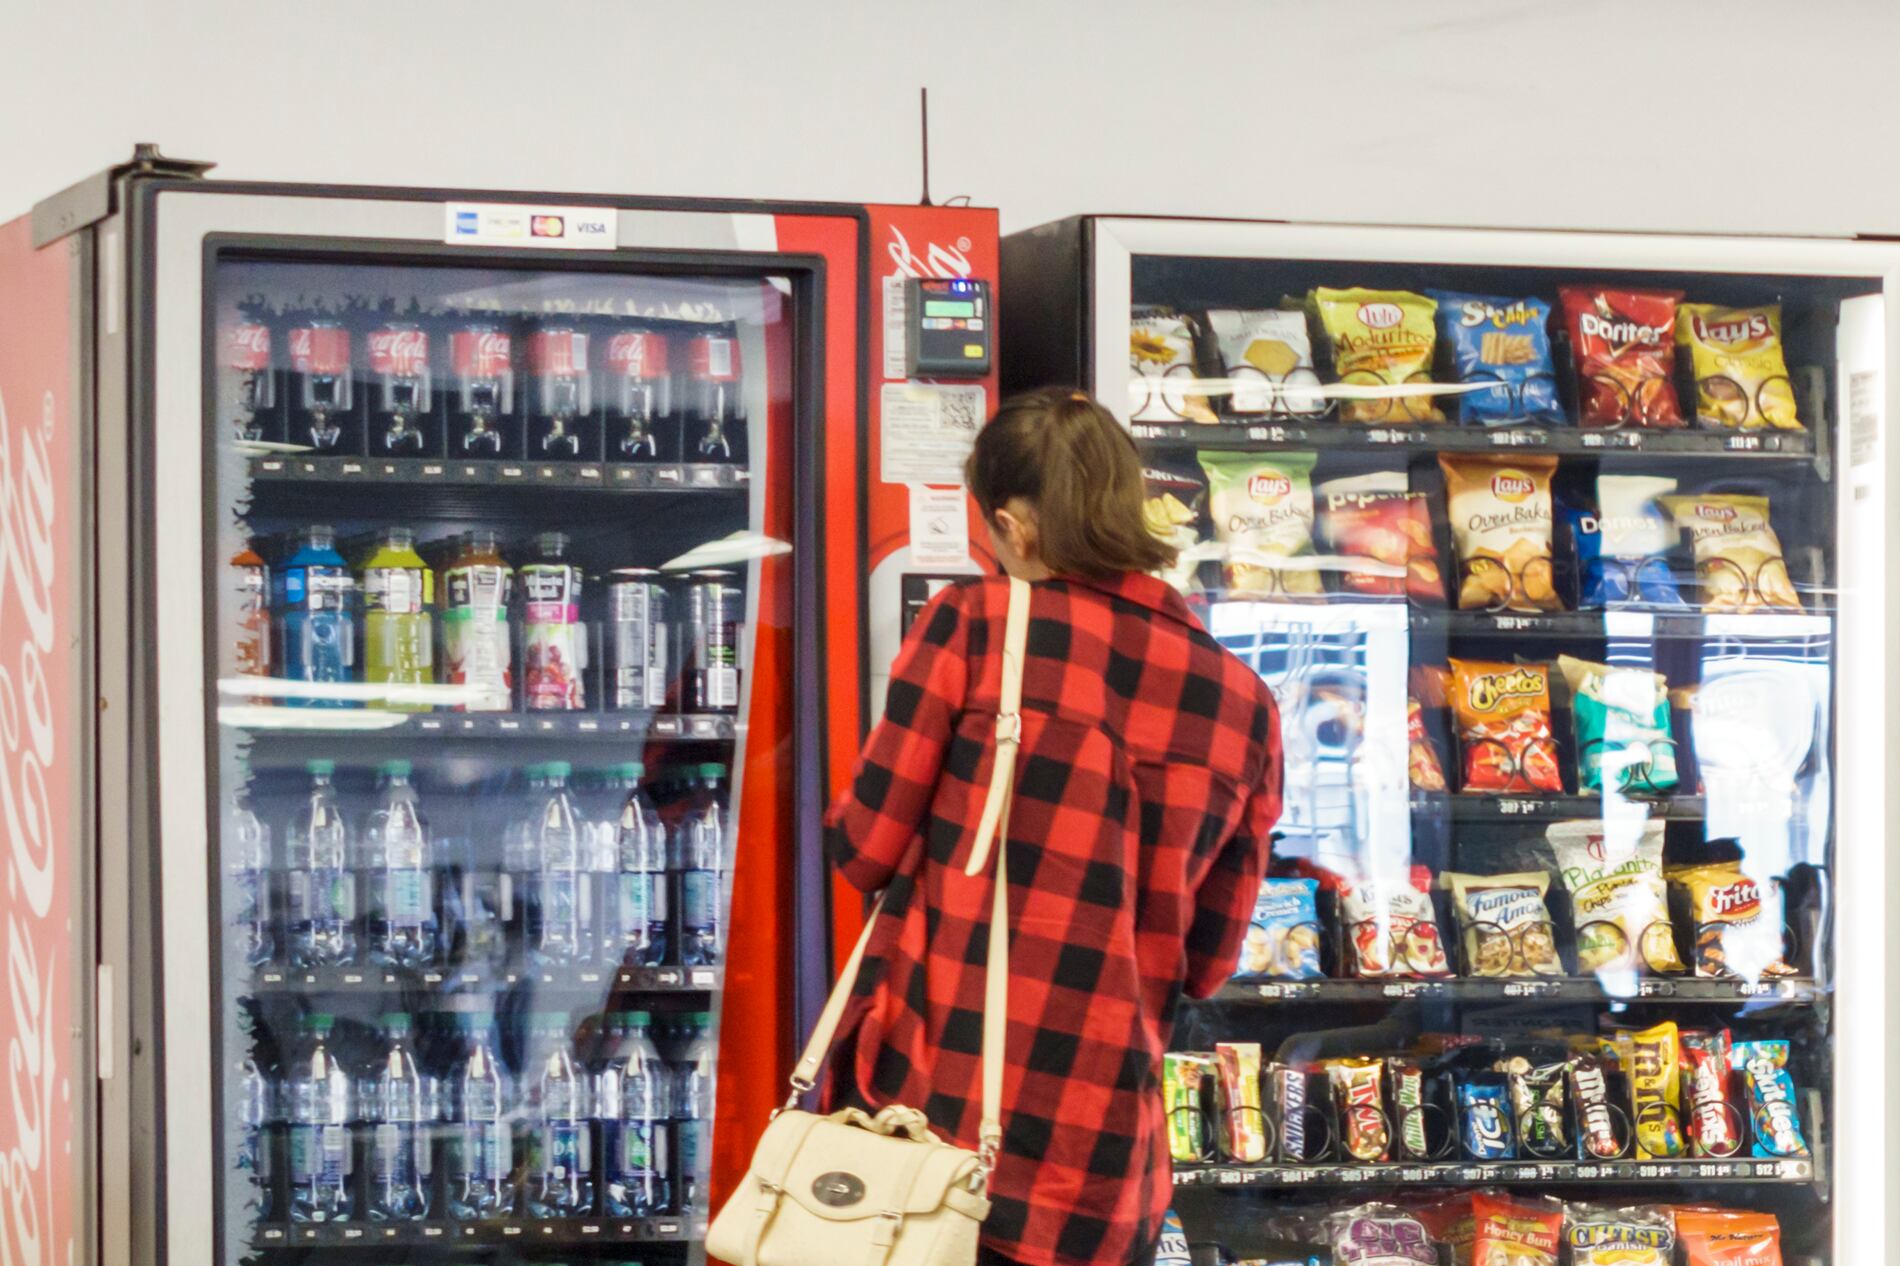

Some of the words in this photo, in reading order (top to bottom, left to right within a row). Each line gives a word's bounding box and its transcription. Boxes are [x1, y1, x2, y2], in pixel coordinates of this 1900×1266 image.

[1580, 312, 1664, 344] Doritos
[1471, 668, 1544, 711] Cheetos
[1470, 889, 1540, 916] Famous
[1711, 880, 1777, 915] Frito
[1496, 903, 1544, 924] Amos
[1284, 1071, 1305, 1160] SNICKERS
[1483, 1223, 1523, 1243] Honey
[1527, 1232, 1552, 1249] Bun
[1569, 1224, 1673, 1250] CHEESE
